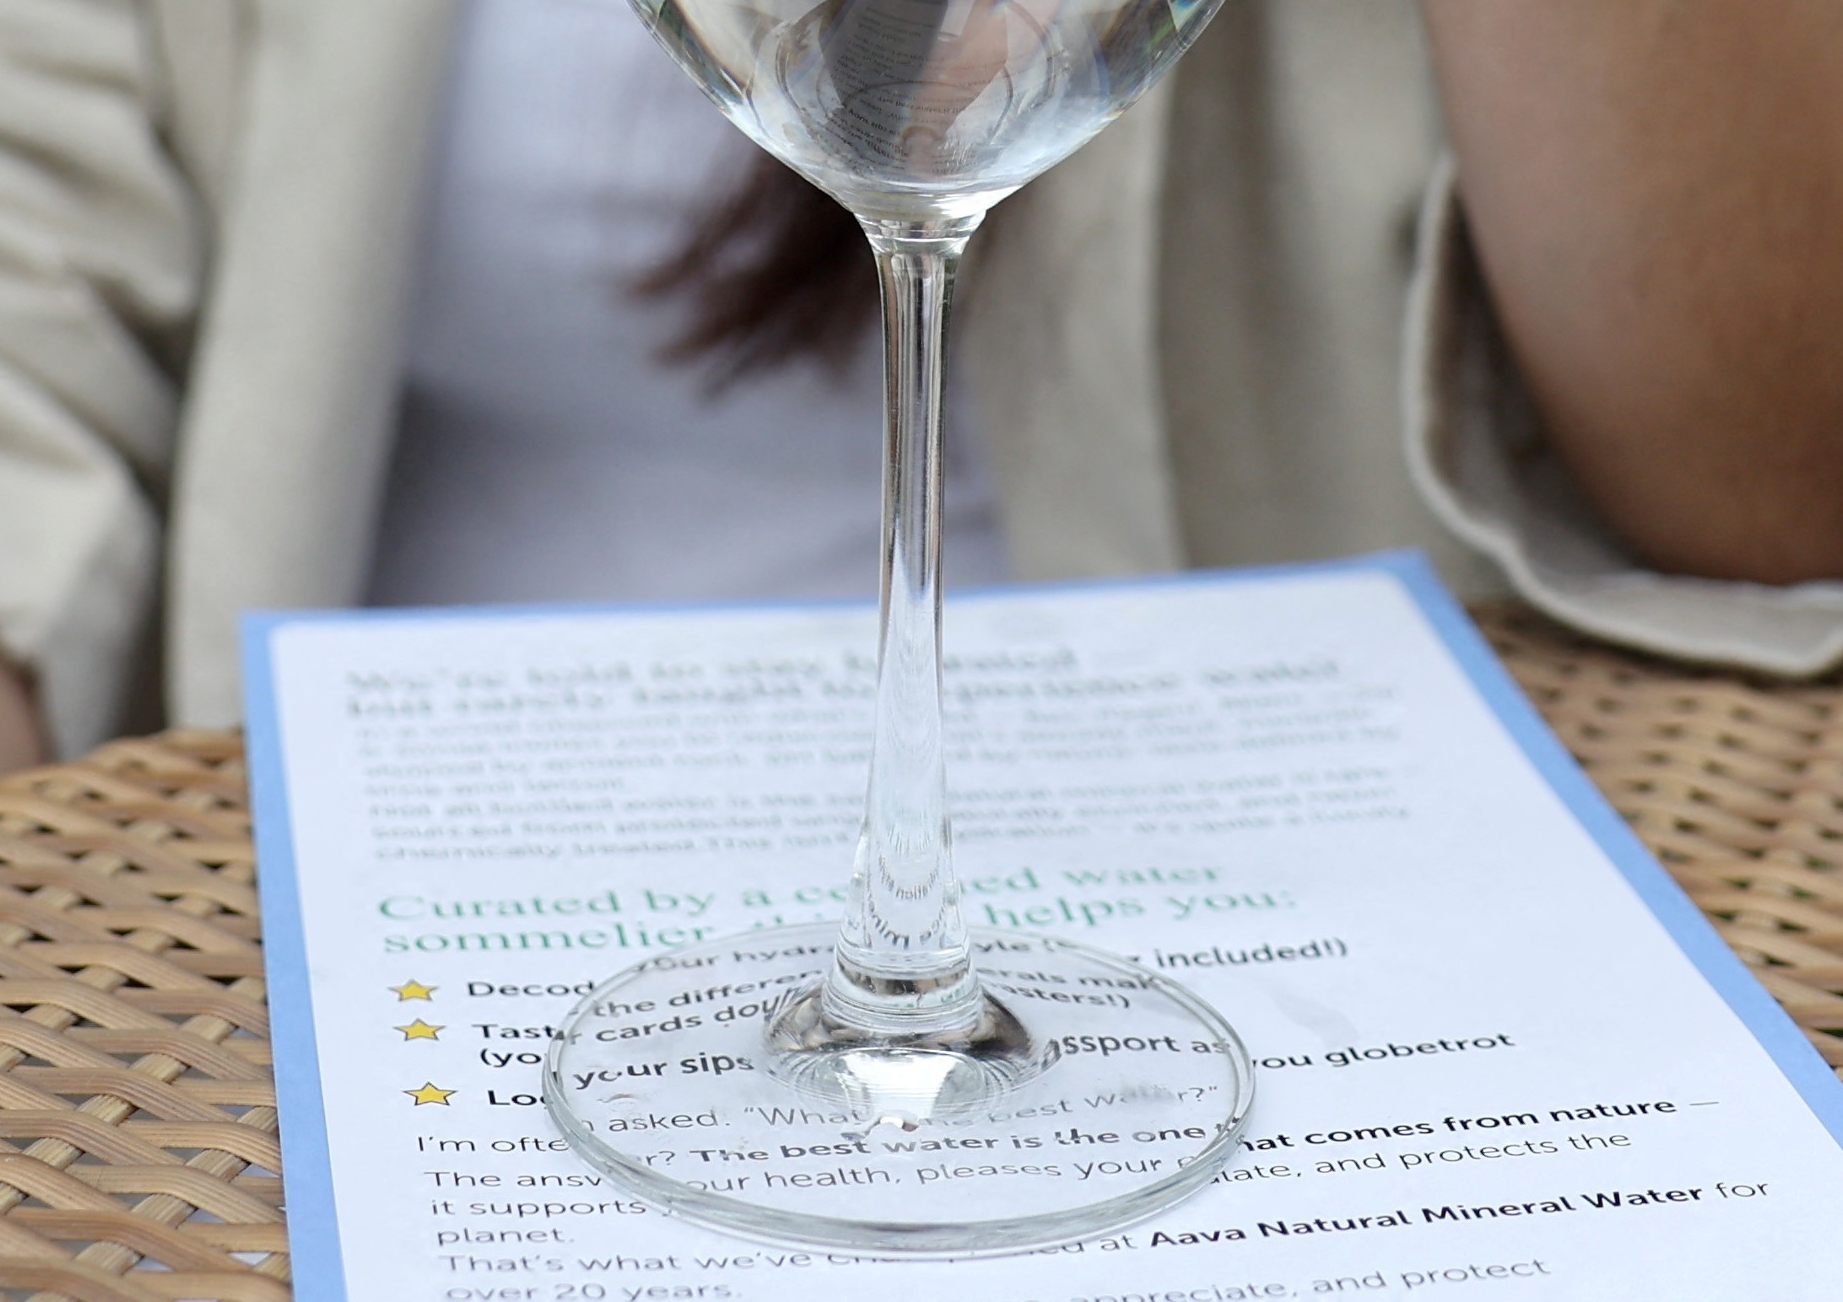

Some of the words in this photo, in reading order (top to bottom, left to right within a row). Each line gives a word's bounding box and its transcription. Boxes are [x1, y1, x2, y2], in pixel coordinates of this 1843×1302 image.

[378, 884, 621, 922] Curated
[646, 887, 717, 919] by
[741, 886, 773, 908] a
[1061, 864, 1226, 887] water
[383, 921, 715, 954] sommelier
[984, 894, 1145, 931] helps
[467, 978, 596, 999] Decod
[1154, 936, 1349, 970] included!)
[472, 1023, 555, 1040] Tast
[595, 1013, 703, 1043] cards
[680, 1051, 755, 1076] sips
[1325, 1029, 1517, 1070] globetrot
[424, 1170, 502, 1188] The
[690, 1147, 770, 1164] The
[780, 1140, 872, 1159] best
[883, 1134, 998, 1153] water
[1009, 1133, 1042, 1150] is
[1055, 1127, 1121, 1147] the
[1130, 1125, 1206, 1143] one
[1303, 1121, 1435, 1147] comes
[1443, 1108, 1540, 1134] from
[1549, 1096, 1679, 1126] nature
[430, 1198, 455, 1217] it
[470, 1197, 648, 1219] supports
[764, 1159, 901, 1189] health,
[917, 1155, 1062, 1185] pleases
[1074, 1156, 1163, 1182] your
[1316, 1152, 1387, 1176] and
[1399, 1135, 1559, 1173] protects
[1567, 1127, 1633, 1152] the
[436, 1226, 576, 1248] planet.
[438, 1254, 563, 1273] That's
[577, 1252, 682, 1272] what
[693, 1250, 813, 1271] we've
[1099, 1233, 1139, 1253] at
[1150, 1225, 1248, 1249] Aava
[1257, 1208, 1414, 1240] Natural
[1421, 1194, 1578, 1225] Mineral
[1583, 1182, 1705, 1211] Water
[1713, 1176, 1773, 1199] for
[445, 1284, 540, 1302] over
[554, 1282, 607, 1301] 20
[1311, 1270, 1388, 1296] and
[1398, 1256, 1552, 1290] protect
